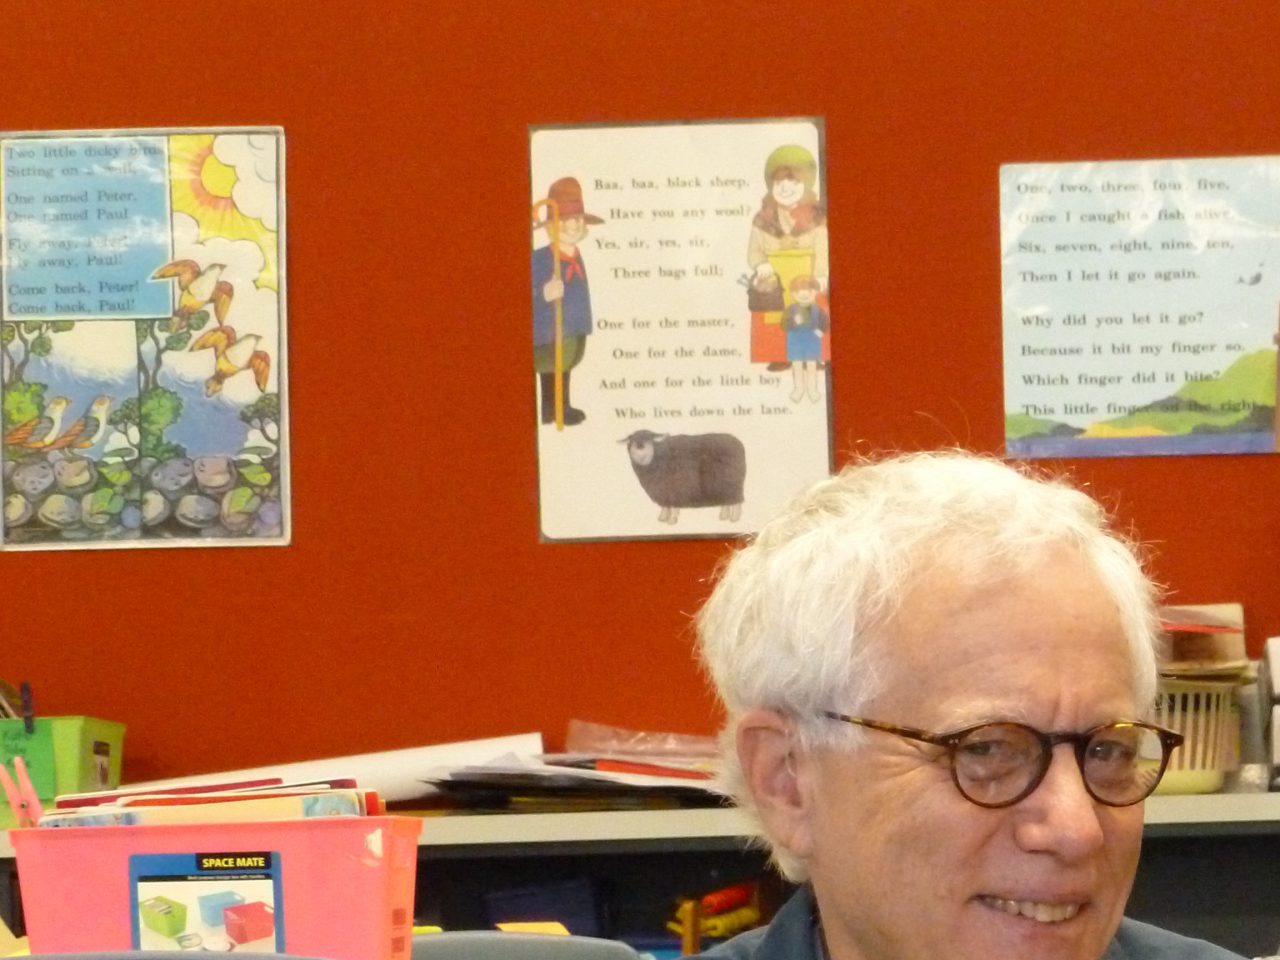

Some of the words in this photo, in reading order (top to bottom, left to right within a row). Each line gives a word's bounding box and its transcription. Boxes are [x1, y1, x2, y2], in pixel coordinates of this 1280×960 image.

[6, 147, 35, 159] Two
[43, 147, 77, 158] little
[84, 145, 120, 158] dicky
[6, 166, 54, 178] Sitting
[62, 168, 78, 176] on
[594, 179, 623, 191] Baa,
[632, 178, 659, 189] baa,
[667, 177, 702, 188] black
[1060, 183, 1093, 194] two,
[1197, 179, 1230, 191] five,
[7, 193, 33, 205] One
[43, 191, 88, 203] named
[97, 190, 138, 202] Peter,
[610, 208, 643, 219] Have
[651, 209, 675, 222] you
[683, 209, 706, 221] any
[715, 205, 751, 217] wool?
[1066, 211, 1071, 222] I
[1080, 211, 1131, 225] caught
[1158, 209, 1185, 221] fish
[595, 239, 620, 250] Yes,
[628, 238, 650, 249] sir,
[1018, 241, 1046, 253] Six,
[1055, 242, 1102, 253] seven,
[1110, 240, 1152, 253] eight,
[1206, 239, 1235, 250] ten,
[38, 257, 79, 269] away,
[610, 267, 651, 279] Three
[658, 266, 686, 279] bags
[1019, 271, 1057, 283] Then
[1067, 270, 1072, 281] I
[1081, 270, 1100, 281] let
[1108, 269, 1119, 280] it
[1128, 272, 1146, 283] go
[1154, 268, 1200, 281] again.
[8, 284, 47, 296] Come
[54, 282, 91, 294] back,
[8, 303, 47, 314] Come
[54, 301, 92, 314] back,
[597, 319, 623, 330] One
[632, 318, 651, 329] for
[659, 318, 680, 329] the
[687, 319, 735, 329] master,
[1021, 315, 1053, 329] Why
[1062, 314, 1086, 326] did
[1095, 315, 1123, 329] you
[1132, 313, 1151, 325] let
[1160, 312, 1170, 324] it
[1178, 312, 1204, 326] go?
[612, 348, 640, 360] One
[648, 347, 666, 358] for
[674, 347, 695, 357] the
[1021, 345, 1083, 357] Because
[1092, 343, 1103, 355] it
[1111, 343, 1131, 355] bit
[1140, 344, 1163, 357] my
[1171, 341, 1217, 355] finger
[599, 378, 626, 390] And
[633, 379, 657, 389] one
[665, 377, 684, 388] for
[692, 376, 713, 387] the
[720, 375, 751, 386] little
[759, 375, 782, 387] boy
[1022, 374, 1069, 386] Which
[1077, 372, 1123, 387] finger
[1131, 371, 1156, 384] did
[1165, 371, 1175, 383] it
[1184, 370, 1221, 382] bite?
[614, 407, 646, 419] Who
[653, 406, 682, 418] lives
[689, 406, 724, 417] down
[733, 405, 756, 416] the
[1022, 403, 1055, 416] This
[1064, 402, 1098, 414] little
[1107, 402, 1150, 417] finger
[202, 857, 234, 868] SPACE
[236, 857, 265, 867] MATE
